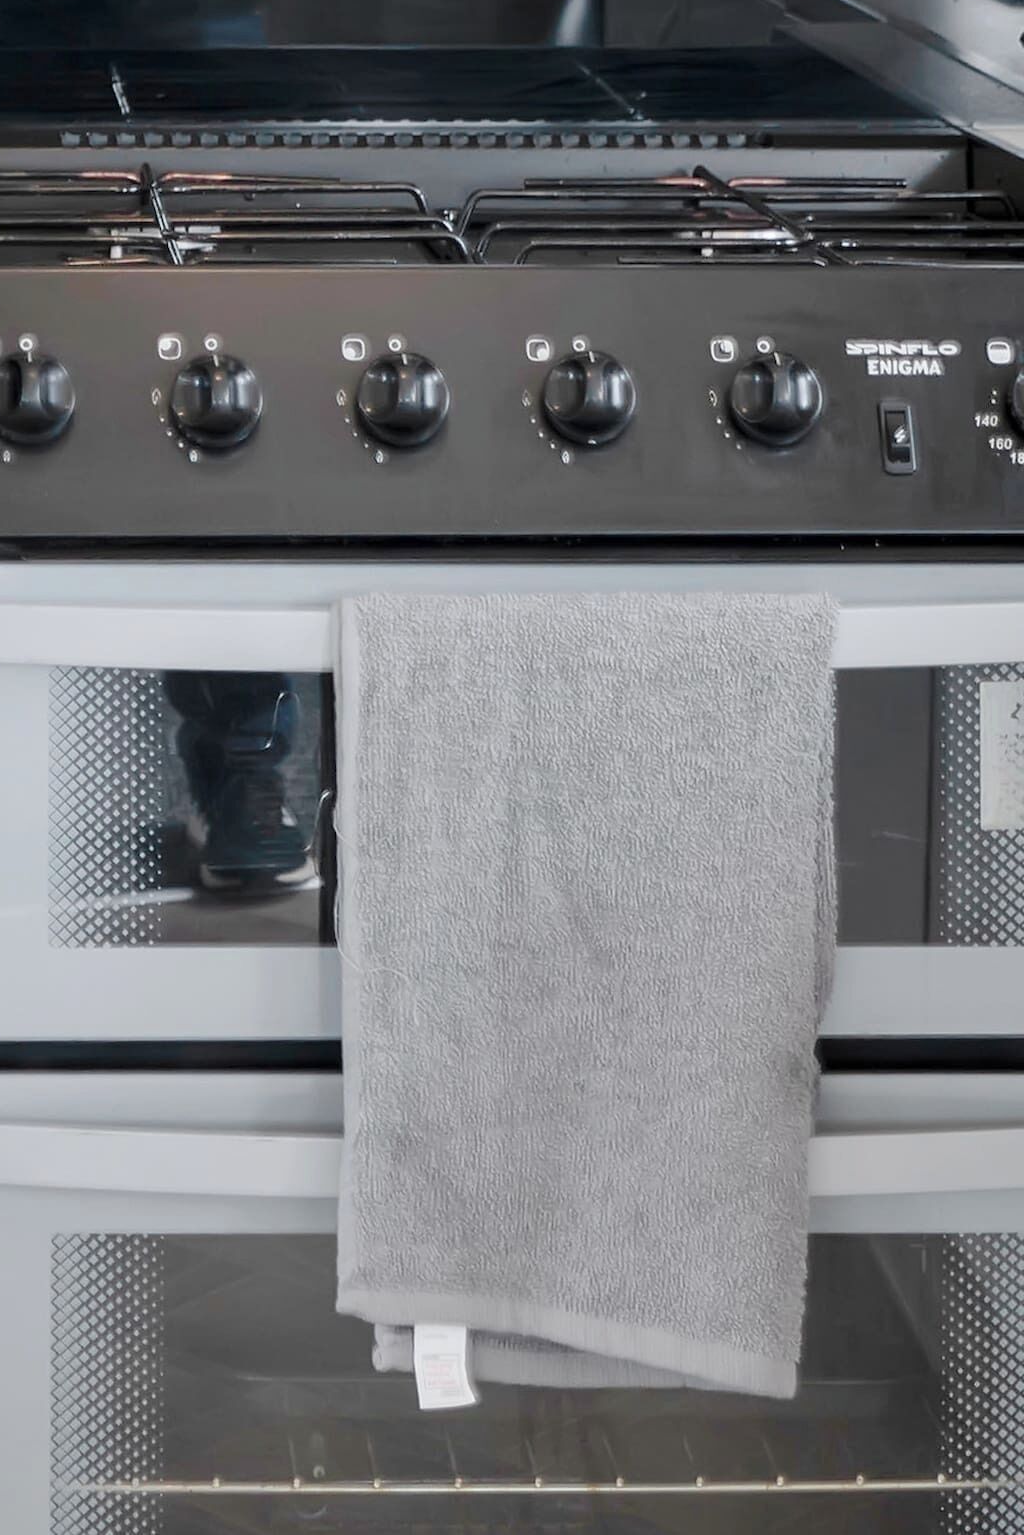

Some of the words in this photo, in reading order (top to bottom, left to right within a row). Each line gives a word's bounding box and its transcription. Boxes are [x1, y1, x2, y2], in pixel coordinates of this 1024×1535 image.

[845, 342, 959, 356] SPINFLO
[867, 359, 942, 376] ENIGMA
[974, 415, 998, 427] 140
[989, 438, 1012, 450] 160
